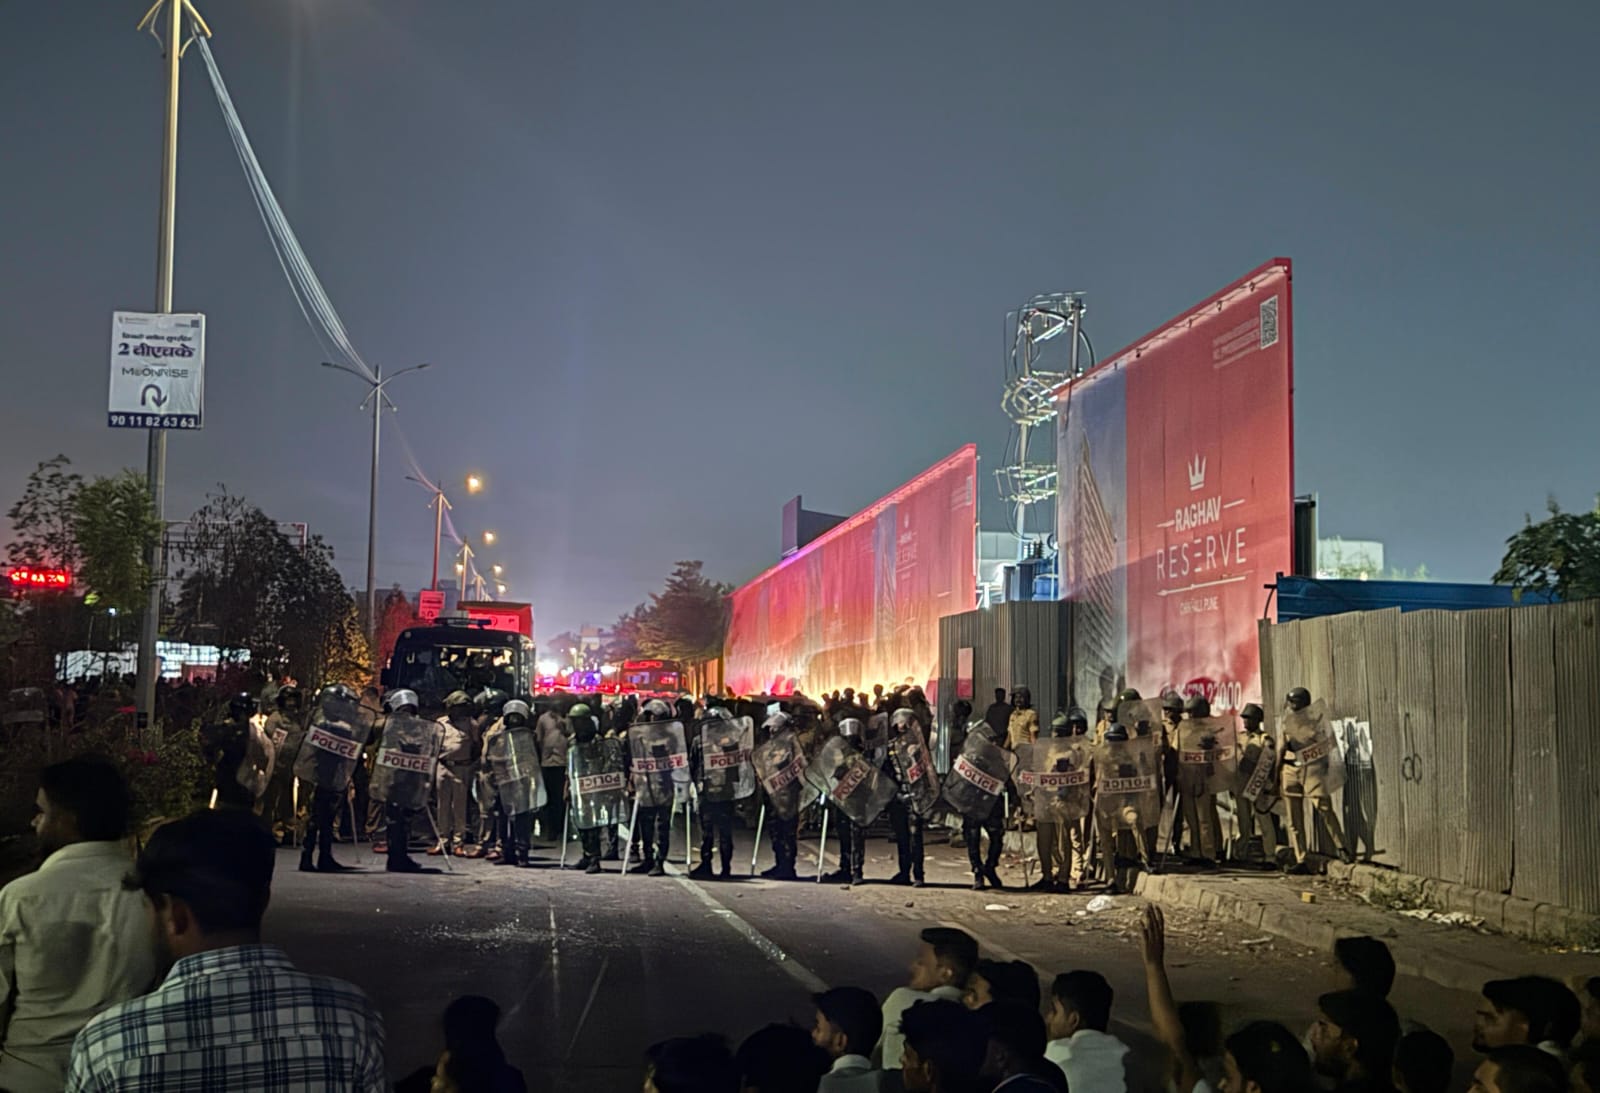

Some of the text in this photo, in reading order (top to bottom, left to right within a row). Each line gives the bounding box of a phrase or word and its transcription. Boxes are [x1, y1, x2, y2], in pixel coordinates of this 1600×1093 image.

[118, 342, 130, 356] 2
[111, 415, 125, 425] 90
[129, 415, 142, 425] 11
[163, 417, 177, 427] 63
[180, 418, 195, 428] 63
[1175, 496, 1222, 532] RAGHAV
[1156, 527, 1247, 582] RESERVE
[311, 733, 355, 758] POLICE
[383, 755, 431, 771] POLICE
[637, 758, 685, 771] POLICE
[834, 763, 867, 800] POLICE
[959, 763, 997, 792] POLICE
[1040, 773, 1085, 786] POLICE
